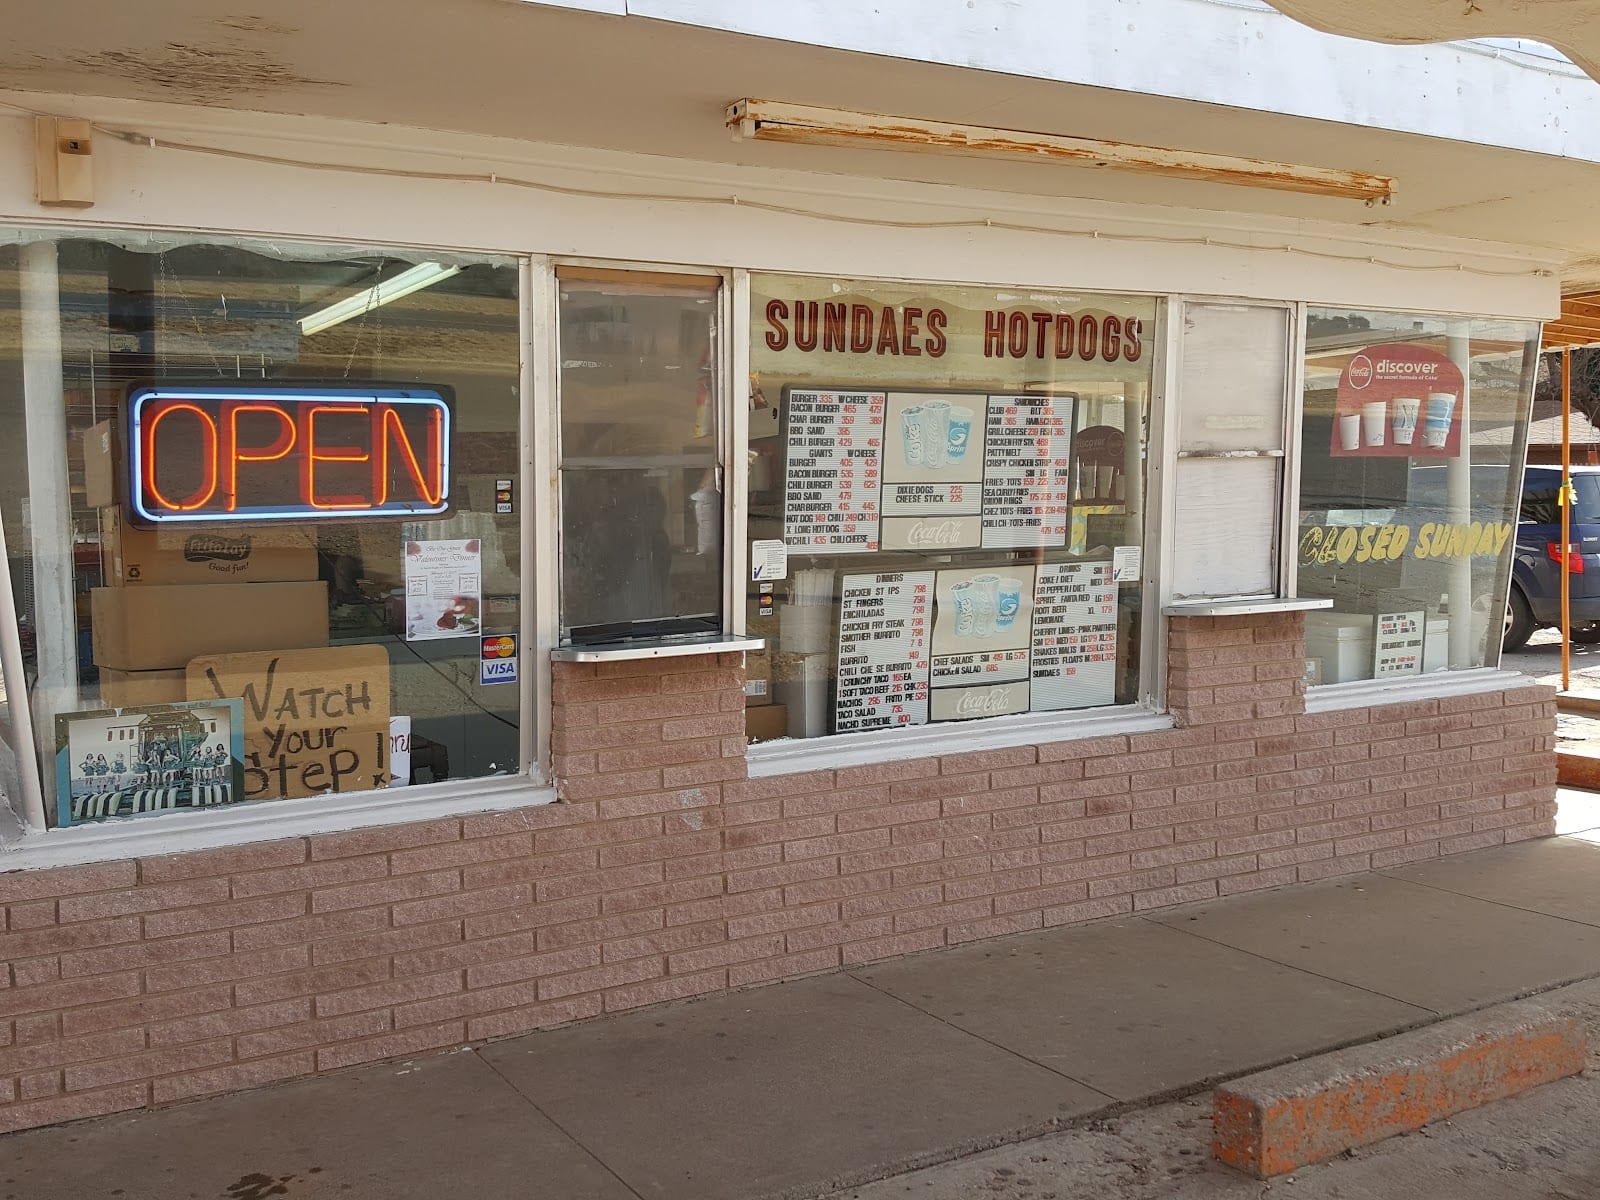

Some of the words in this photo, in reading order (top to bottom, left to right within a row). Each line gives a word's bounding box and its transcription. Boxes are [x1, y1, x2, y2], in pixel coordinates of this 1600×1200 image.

[765, 299, 946, 358] SUNDAES
[984, 310, 1143, 362] HOTDOGS
[1376, 359, 1438, 374] discover
[792, 394, 817, 402] BURGER
[819, 395, 833, 403] 335
[791, 404, 812, 412] BACON
[790, 415, 807, 423] CHAR
[810, 416, 833, 424] BURGER
[807, 427, 825, 435] SAND
[789, 438, 806, 446] CHILI
[809, 438, 834, 446] BURGER
[141, 401, 441, 511] OPEN
[809, 449, 832, 457] GIANTS
[789, 470, 810, 478] BACON
[1007, 478, 1021, 486] TOTS
[803, 492, 821, 500] SAND
[896, 495, 920, 503] CHEESE
[950, 494, 963, 502] 225
[1300, 523, 1410, 565] CLOSED
[1415, 522, 1512, 559] SUNDAY
[209, 562, 231, 573] Good
[232, 561, 249, 575] fun!
[1039, 576, 1055, 584] COKE
[844, 588, 871, 597] CHICKEN
[844, 600, 851, 608] ST
[856, 598, 883, 607] FINGERS
[843, 609, 884, 619] ENCHILADAS
[1035, 616, 1064, 624] LEMONADE
[842, 622, 869, 631] CHICKEN
[872, 621, 883, 629] FRY
[886, 620, 904, 628] STEAK
[874, 630, 900, 639] BURRITO
[1034, 628, 1056, 636] CHERRY
[483, 643, 515, 652] MasterCard
[841, 645, 855, 653] FISH
[1034, 648, 1057, 656] SHAKES
[1059, 646, 1076, 654] MALTS
[841, 656, 868, 665] BURRITO
[909, 651, 919, 659] 149
[934, 657, 949, 667] CHEF
[951, 655, 973, 665] SALADS
[980, 654, 989, 662] SM
[1033, 658, 1059, 666] FROSTIES
[1063, 656, 1083, 664] FLOATS
[486, 662, 515, 675] VISA
[840, 667, 856, 676] CHILI
[886, 663, 911, 672] BURRITO
[933, 667, 959, 676] CHICKEN
[961, 665, 981, 674] SALAD
[1033, 669, 1060, 677] SUNDAES
[874, 675, 889, 683] TACO
[206, 657, 371, 721] WATCH
[838, 699, 862, 708] NACHOS
[886, 695, 902, 703] FRITO
[838, 710, 852, 719] TACO
[855, 708, 875, 717] SALAD
[838, 721, 858, 730] NACHO
